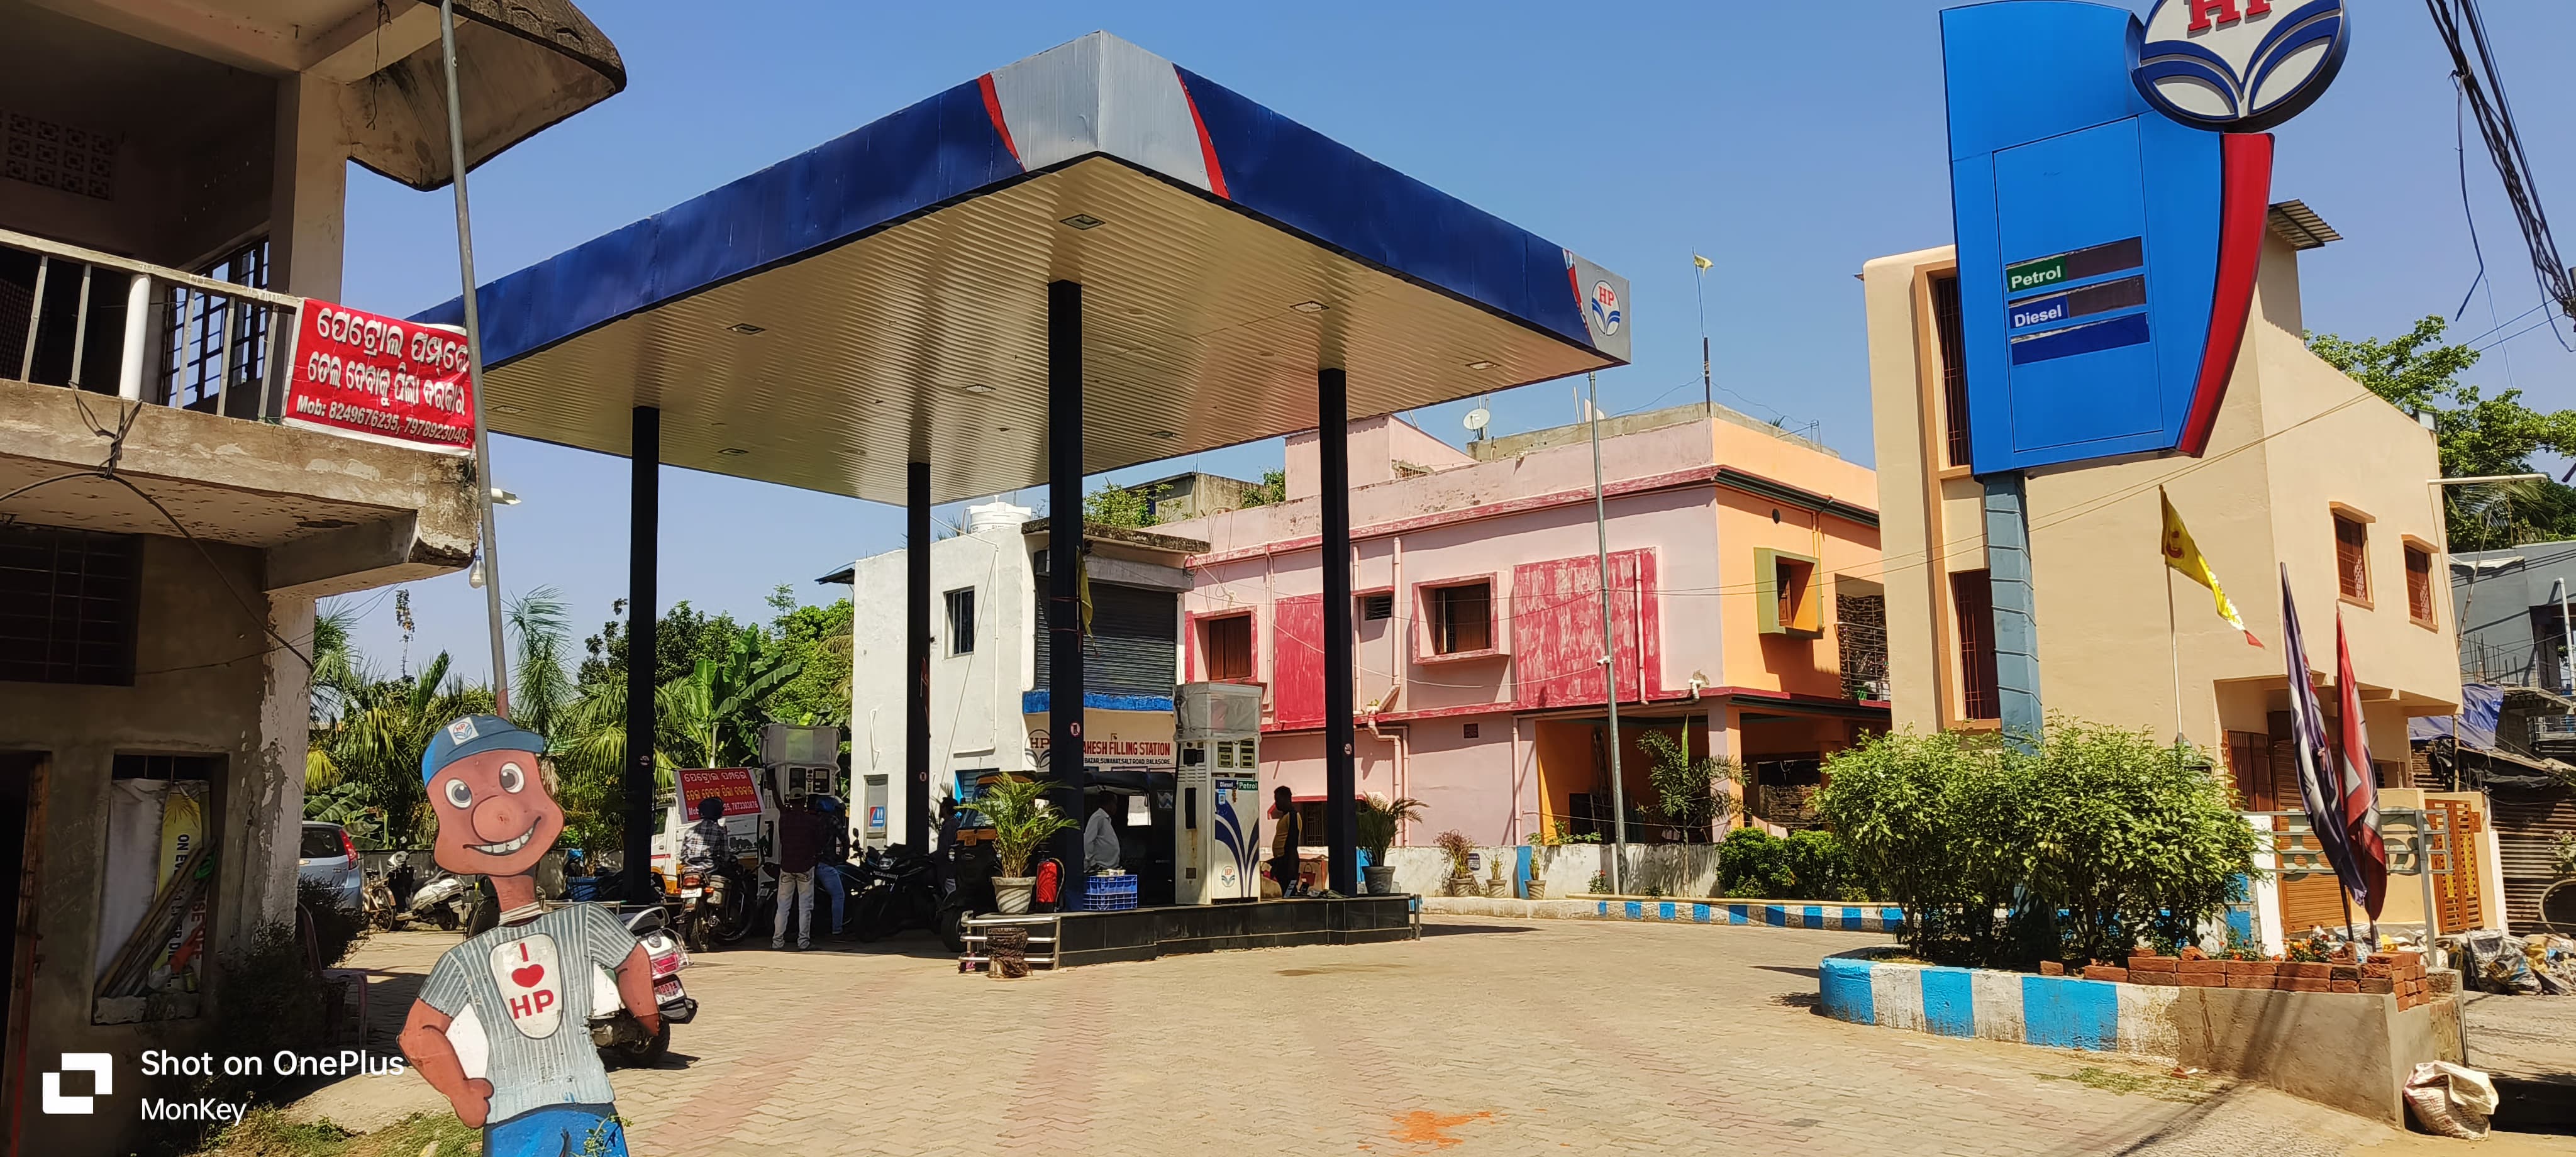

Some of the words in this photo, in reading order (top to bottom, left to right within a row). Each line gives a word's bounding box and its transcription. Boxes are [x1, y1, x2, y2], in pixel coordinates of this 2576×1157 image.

[2011, 265, 2062, 289] Petrol
[1598, 285, 1614, 307] HP
[2014, 304, 2062, 328] Diesel
[317, 307, 404, 359] ପେଟ୍ରୋଲ
[308, 351, 342, 389] ତେଲ
[346, 360, 391, 407] ଦେବାକୁ
[394, 362, 419, 406] ପିଲା
[423, 379, 465, 416] ଦରକାର
[296, 395, 326, 417] Mob:
[328, 401, 400, 435] 8249676235,
[455, 724, 465, 732] HP
[1030, 737, 1050, 749] HP
[1109, 741, 1138, 755] FILLING
[1139, 741, 1170, 756] STATION
[684, 772, 719, 783] ପେଟ୍ରୋଲ
[1239, 782, 1257, 790] Petrol
[176, 834, 190, 851] ON
[519, 942, 529, 963] I
[509, 989, 554, 1019] HP
